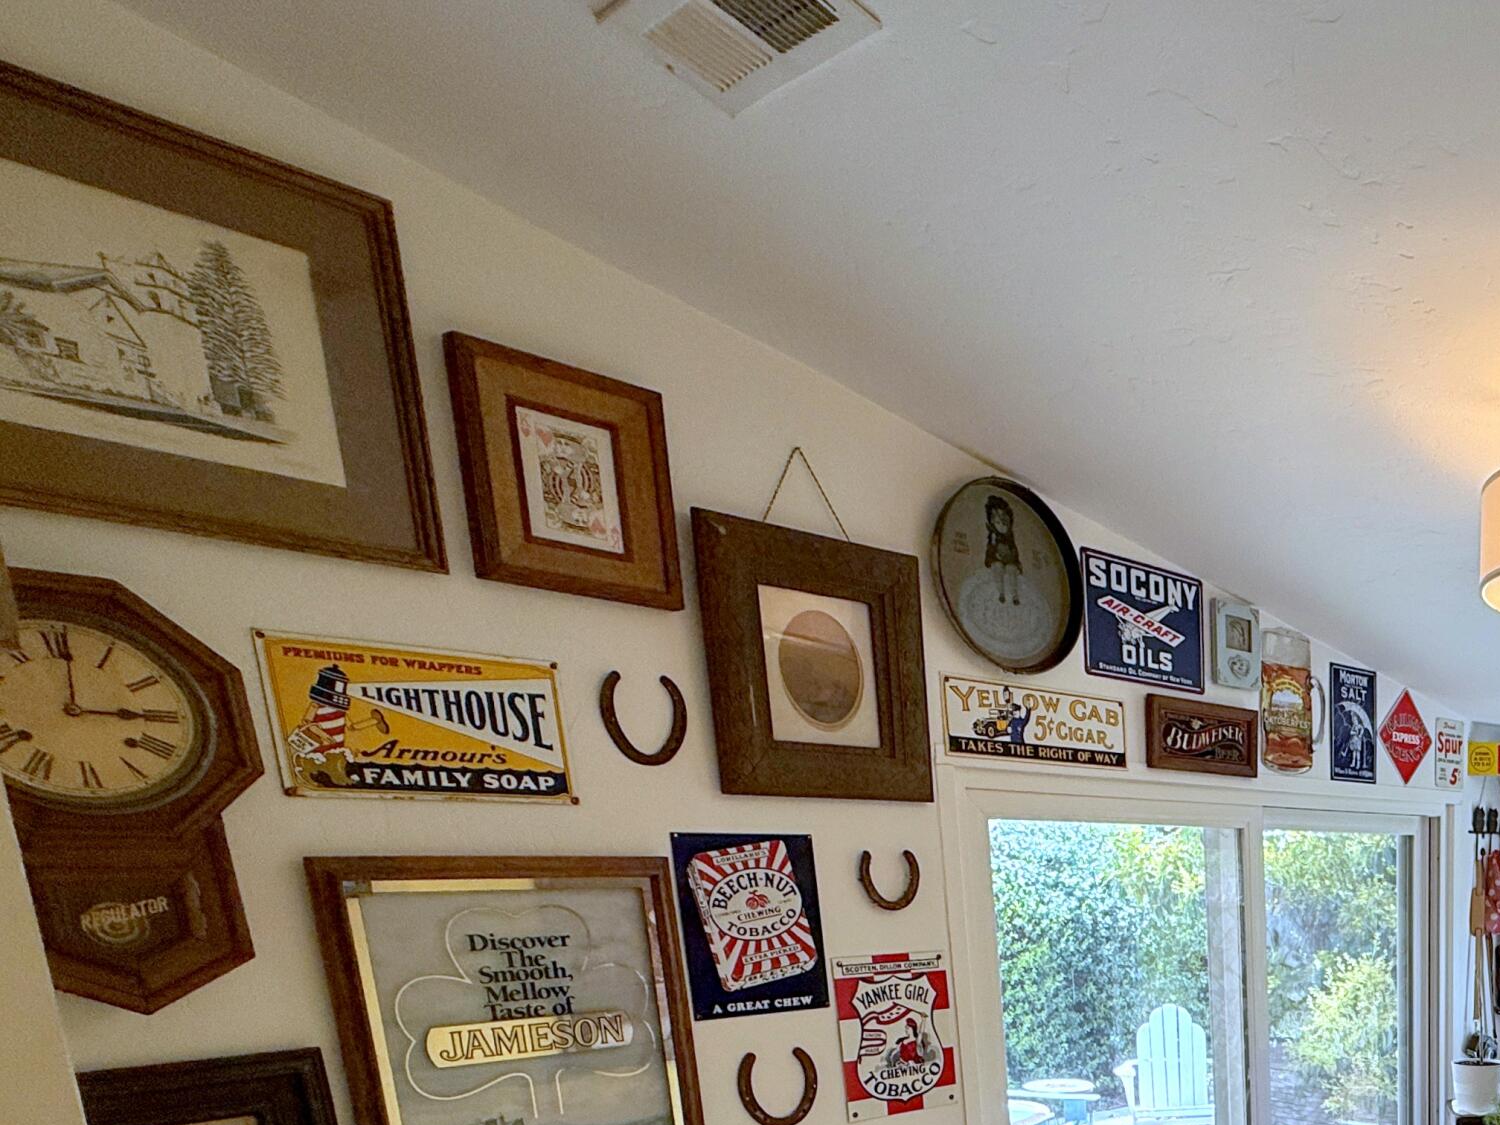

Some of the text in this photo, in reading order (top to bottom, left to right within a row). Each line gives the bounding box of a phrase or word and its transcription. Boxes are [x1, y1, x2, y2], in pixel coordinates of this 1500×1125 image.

[1088, 557, 1197, 610] SOCONY
[1103, 598, 1181, 643] AIR-CRAFT
[282, 646, 482, 676] PREMIUMS FOR WRAPPERS
[1122, 644, 1173, 672] OILS
[1340, 671, 1368, 688] MORTON
[1341, 686, 1367, 702] SALT
[360, 685, 554, 751] LIGHTHOUSE
[1069, 699, 1119, 727] CAB
[1056, 721, 1114, 749] CIGAR
[1392, 731, 1420, 745] EXPRESS
[1437, 731, 1463, 758] Spur
[361, 739, 507, 765] Armour's
[959, 738, 1118, 765] TAKES THE RIGHT OF WAY
[363, 768, 556, 791] FAMILY SOAP
[711, 872, 798, 911] BEECH-NUT
[81, 896, 169, 932] REGULATOR
[726, 908, 797, 938] TOBACCO
[737, 905, 782, 922] CHEWING
[466, 933, 570, 953] Discover
[501, 950, 547, 968] The
[478, 965, 574, 986] Smooth,
[486, 983, 570, 1004] Mellow
[713, 995, 813, 1014] A GREAT CHEW
[856, 983, 930, 1010] YANKEE GIRL
[483, 997, 577, 1021] Taste of
[439, 1015, 625, 1062] JAMESON
[863, 1062, 941, 1097] TOBACCO
[880, 1064, 926, 1080] CHEWING
